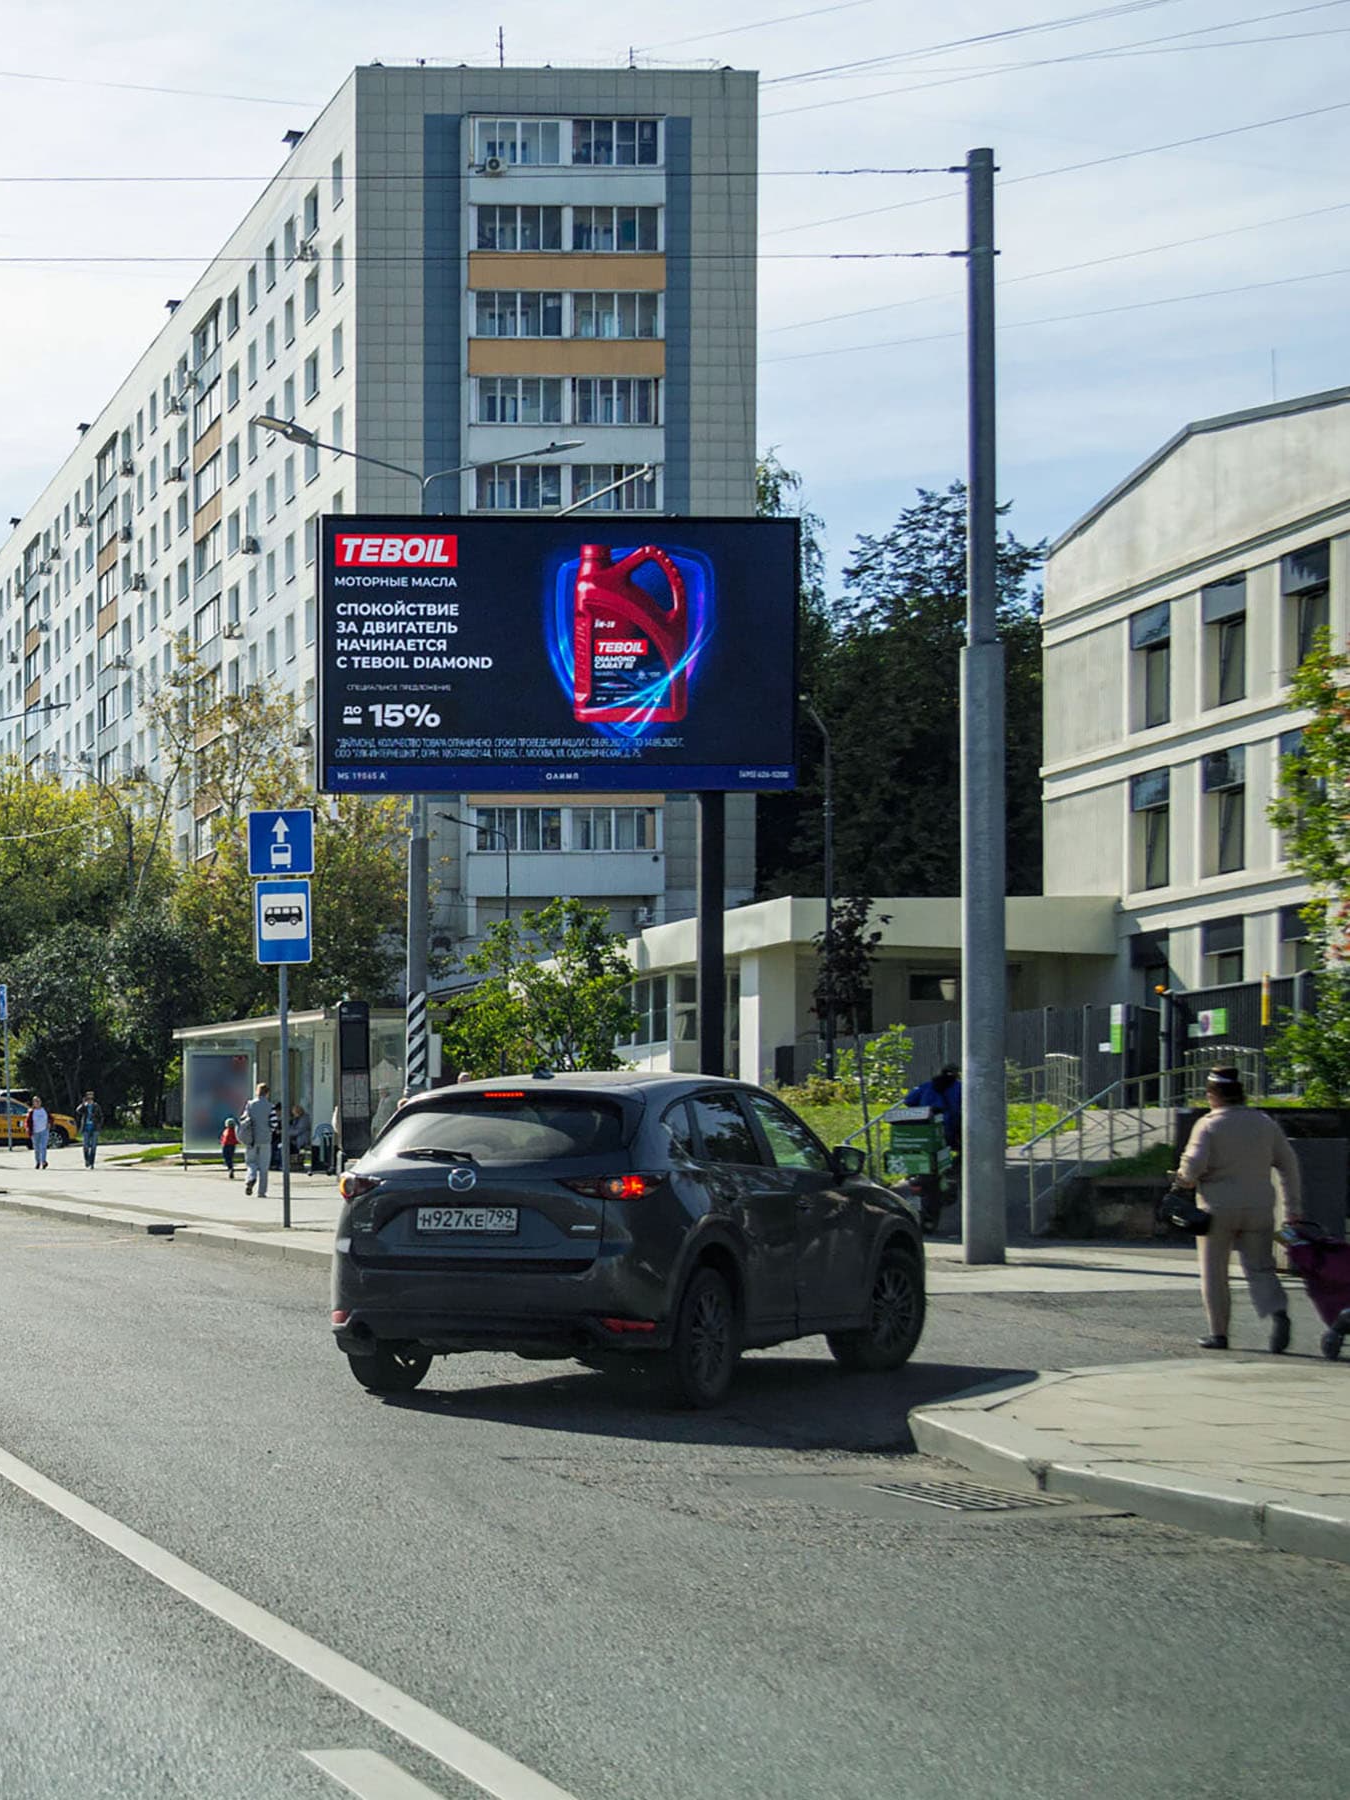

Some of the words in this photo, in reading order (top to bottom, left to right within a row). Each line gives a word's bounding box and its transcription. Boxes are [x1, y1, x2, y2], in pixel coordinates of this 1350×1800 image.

[342, 538, 449, 563] TEBOIL
[334, 577, 409, 588] МОТОРНЫЕ
[411, 578, 458, 588] МАСЛА
[336, 600, 460, 616] СПОКОЙСТВИЕ
[336, 621, 359, 634] ЗА
[362, 621, 459, 636] ДВИГАТЕЛЬ
[336, 639, 448, 652] НАЧИНАЕТСЯ
[597, 642, 644, 653] TEBOIL
[336, 657, 348, 669] С
[351, 657, 410, 669] TEBOIL
[413, 657, 493, 669] DIAMOND
[368, 704, 441, 727] 15%
[488, 1210, 513, 1224] 799
